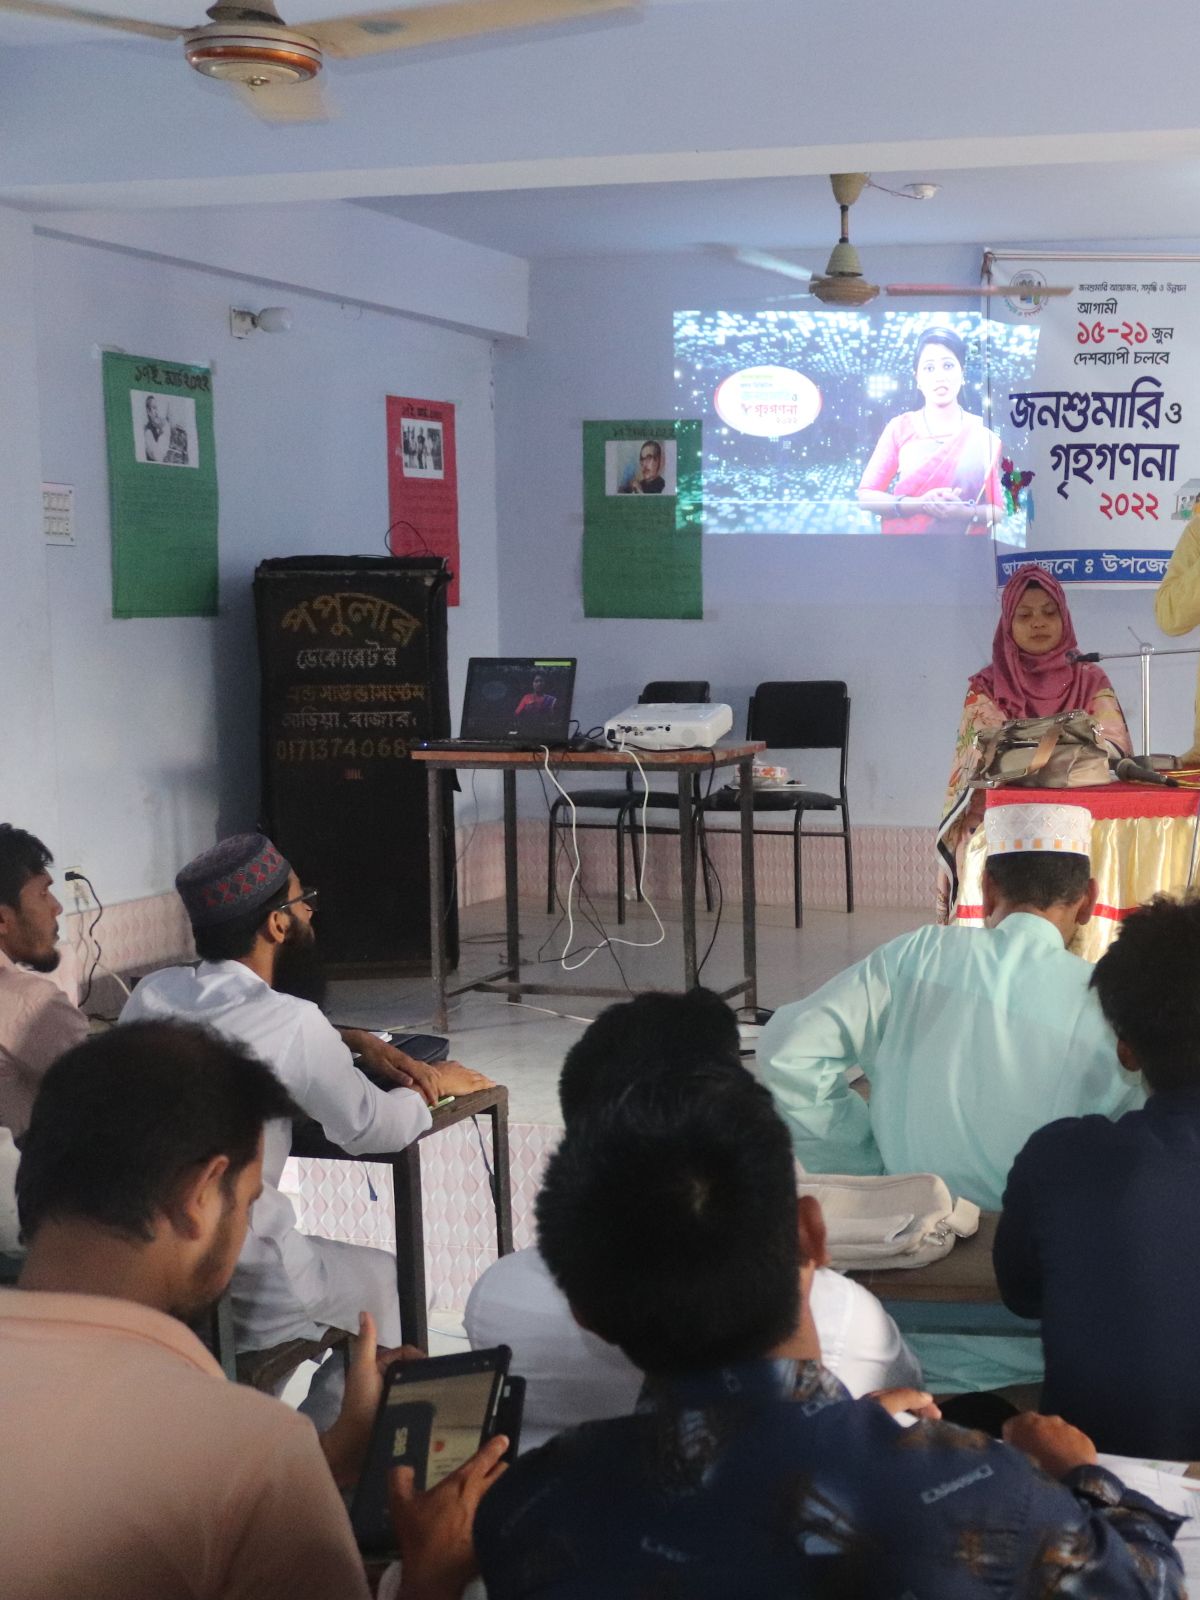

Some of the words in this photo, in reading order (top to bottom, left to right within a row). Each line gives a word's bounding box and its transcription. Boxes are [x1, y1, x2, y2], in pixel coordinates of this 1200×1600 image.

[1159, 284, 1164, 292] ও
[1077, 297, 1118, 315] আগামী
[1077, 321, 1148, 346] ১৫-২১
[1152, 328, 1174, 344] জুন
[1074, 347, 1129, 366] দেশব্যাপী
[1134, 352, 1170, 365] চলবে
[1009, 376, 1164, 433] জনশুমারি
[1165, 402, 1182, 424] ও
[1050, 443, 1180, 499] গৃহগণনা
[1100, 492, 1159, 520] ২০২২
